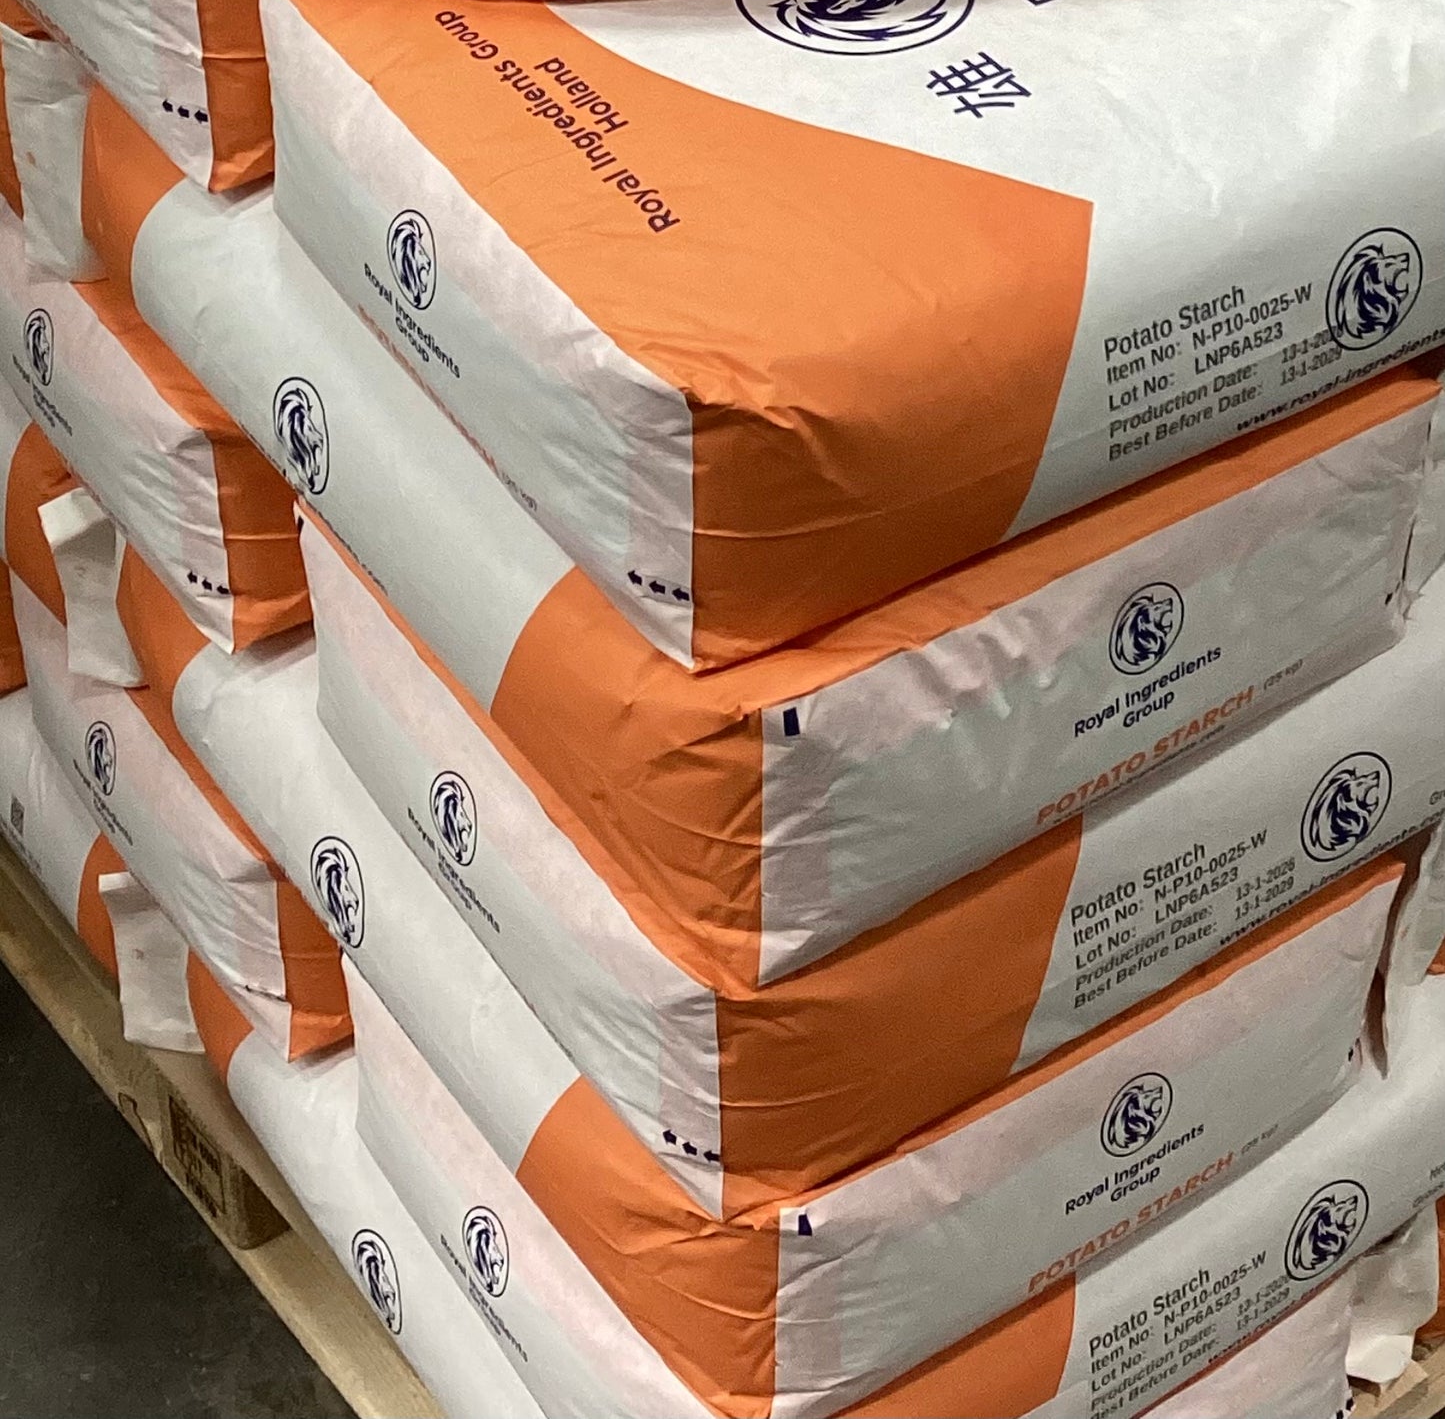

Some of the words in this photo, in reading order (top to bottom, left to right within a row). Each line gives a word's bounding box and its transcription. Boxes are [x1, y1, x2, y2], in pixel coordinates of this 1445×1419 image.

[434, 10, 499, 60] Group
[494, 59, 617, 171] Ingredients
[533, 56, 629, 134] Holland
[602, 168, 681, 233] Royal
[364, 262, 393, 306] Royal
[395, 299, 461, 379] Ingredients
[395, 316, 430, 363] Group
[1104, 319, 1172, 362] Potato
[1178, 286, 1245, 330] Starch
[1106, 356, 1146, 385] Item
[1151, 341, 1182, 367] No:
[1192, 283, 1312, 350] N-P10-0025-W
[1109, 385, 1138, 412] Lot
[1143, 372, 1175, 398] No:
[1194, 321, 1284, 375] LNP6A523
[1110, 384, 1208, 438] Production
[1213, 363, 1259, 393] Date:
[1109, 431, 1150, 462] Best
[1155, 406, 1213, 441] Before
[1218, 384, 1264, 413] Date:
[1074, 698, 1120, 738] Royal
[1125, 647, 1222, 708] Ingredients
[1123, 691, 1175, 729] Group
[1036, 752, 1147, 826] POTATO
[1153, 685, 1255, 758] STARCH
[1071, 881, 1136, 927] Potato
[1143, 843, 1205, 889] Starch
[1073, 917, 1110, 947] Item
[1114, 898, 1144, 923] No:
[1154, 829, 1267, 903] N-P10-0025-W
[1075, 944, 1103, 971] Lot
[1107, 926, 1137, 952] No:
[1155, 866, 1239, 924] LNP6A523
[1075, 930, 1165, 991] Production
[1170, 905, 1214, 935] Date:
[1236, 857, 1296, 902] 13-1-2026
[1074, 977, 1111, 1009] Best
[1116, 946, 1169, 984] Before
[1174, 922, 1218, 950] Date:
[1235, 876, 1295, 921] 13-1-2029
[1065, 1177, 1109, 1215] Royal
[1114, 1124, 1205, 1185] Ingredients
[1110, 1166, 1161, 1203] Group
[1028, 1219, 1131, 1294] POTATO
[1136, 1151, 1236, 1223] STARCH
[1089, 1310, 1147, 1358] Potato
[1153, 1267, 1211, 1316] Starch
[1091, 1345, 1124, 1374] Item
[1129, 1325, 1154, 1350] No:
[1164, 1250, 1266, 1329] N-P10-0025-W
[1091, 1368, 1117, 1393] Lot
[1164, 1286, 1240, 1345] LNP6A523
[1091, 1350, 1174, 1412] Production
[1128, 1363, 1179, 1402] Before
